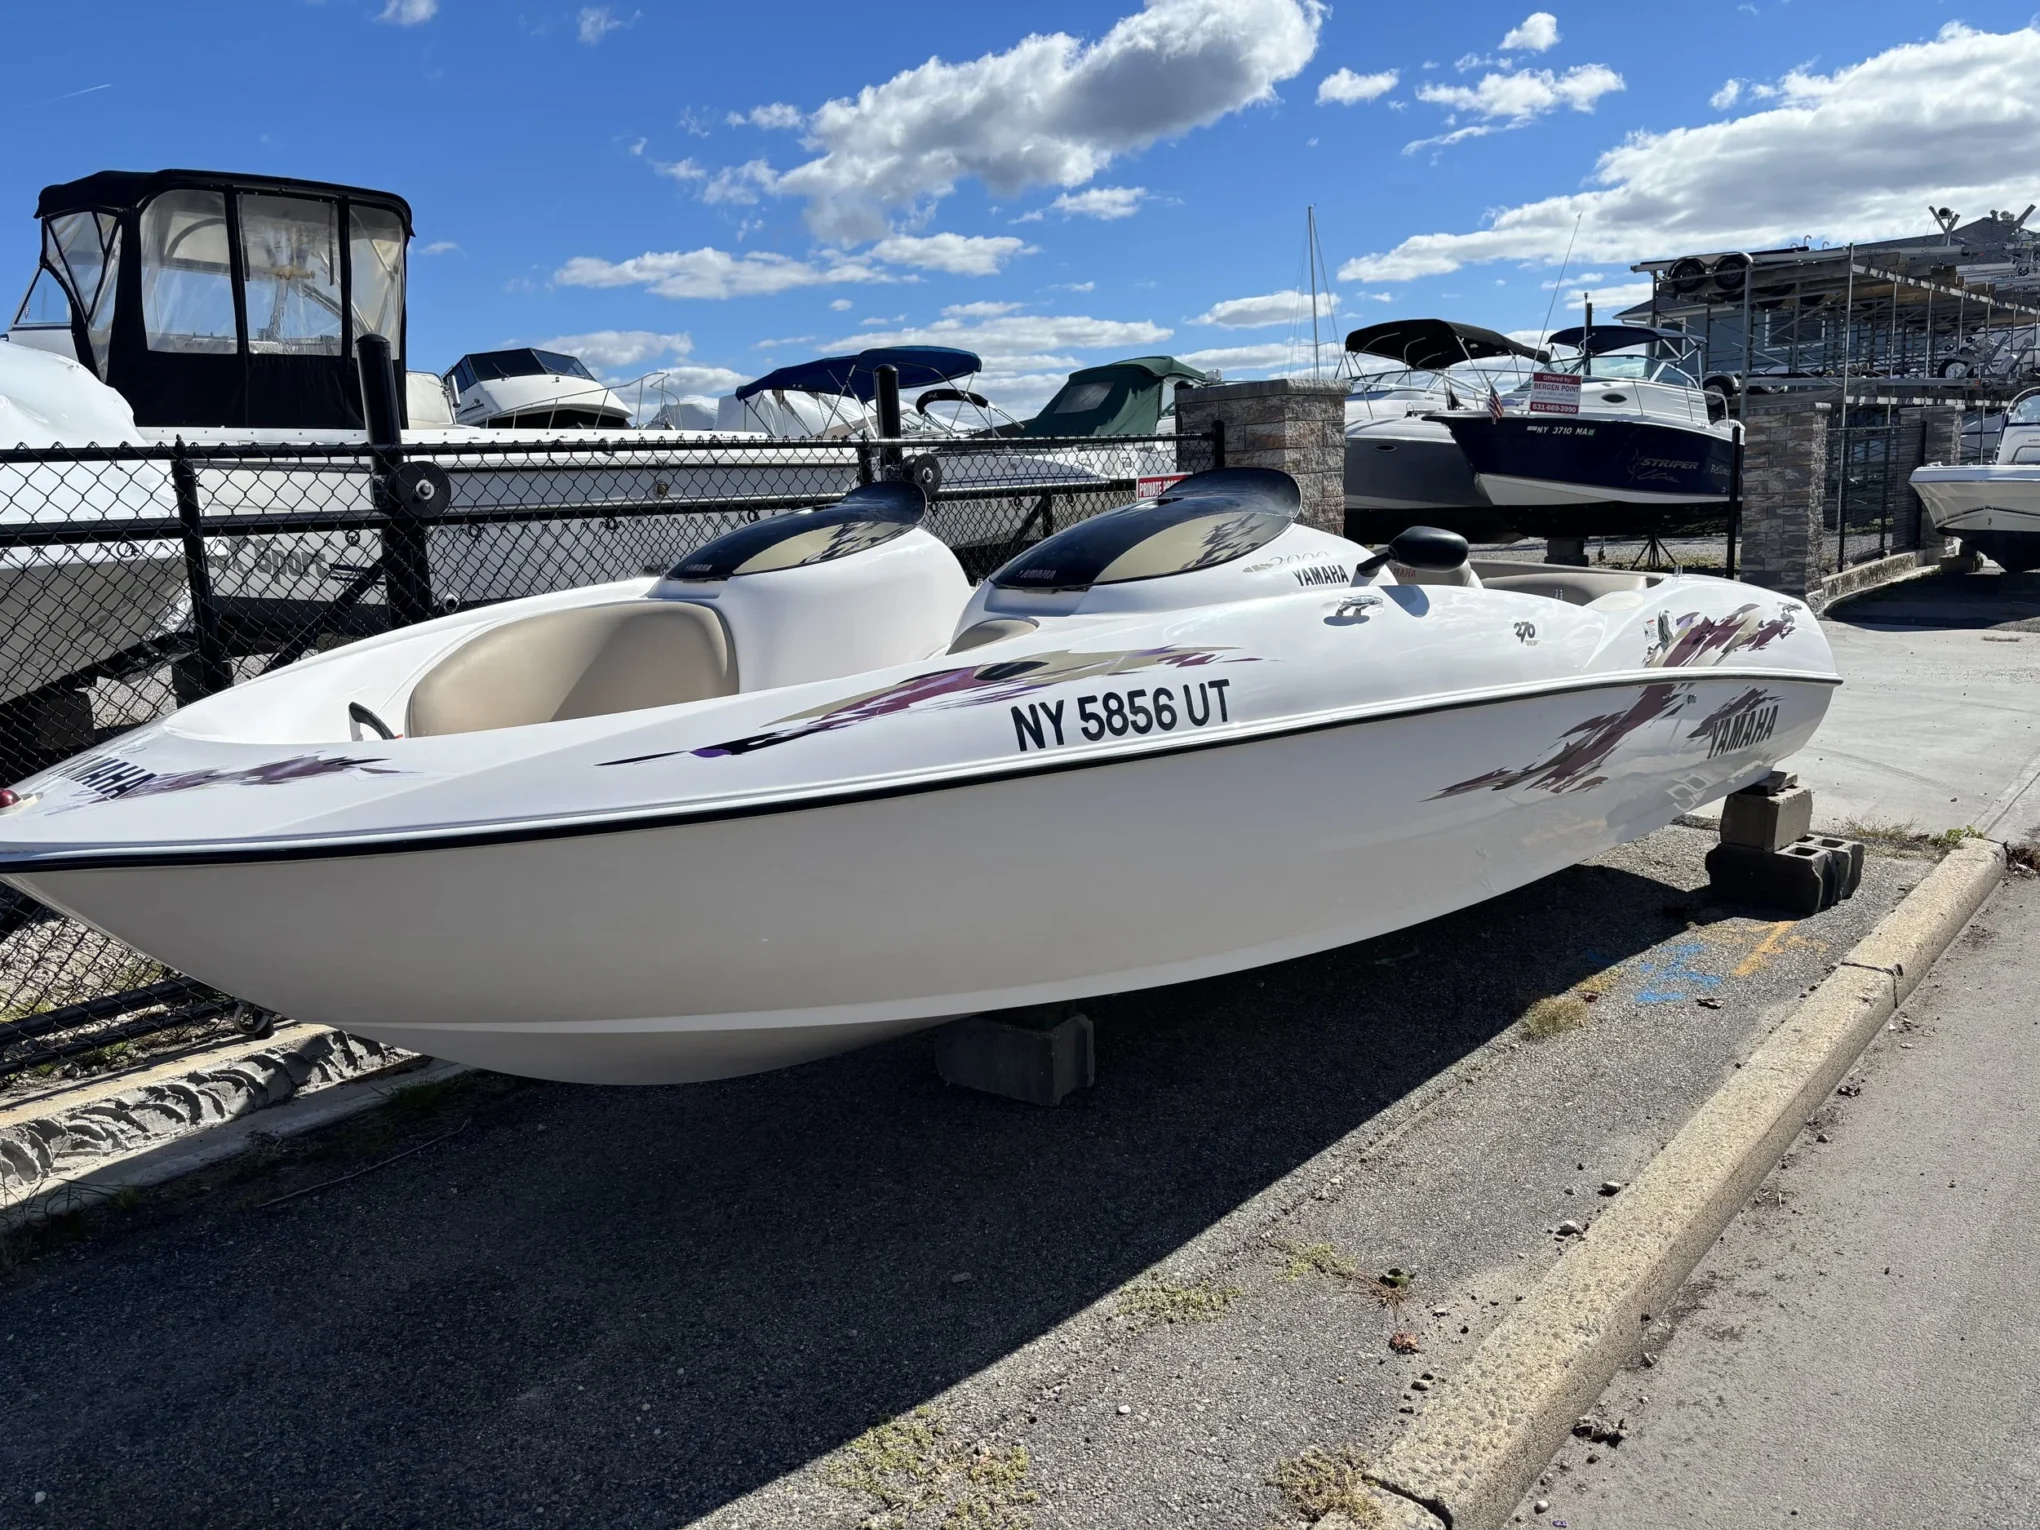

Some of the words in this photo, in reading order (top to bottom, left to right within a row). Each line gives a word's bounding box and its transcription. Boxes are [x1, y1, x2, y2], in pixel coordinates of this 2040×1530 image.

[1533, 383, 1560, 391] BERGEN
[1561, 385, 1580, 393] POINT
[1532, 403, 1577, 413] 631-669-3990
[1536, 426, 1549, 434] NY
[1552, 426, 1573, 435] 3710
[1575, 427, 1588, 435] MA
[1640, 458, 1700, 470] STRIPER
[1139, 480, 1163, 497] PRIVATE
[254, 538, 330, 584] Sport
[684, 563, 713, 572] YAMAHA
[1016, 569, 1057, 580] YAMAHA
[1292, 564, 1350, 587] YAMAHA
[1513, 621, 1536, 644] 270
[1010, 699, 1065, 752] NY
[1077, 687, 1178, 742] 5856
[1183, 678, 1231, 727] UT
[1706, 704, 1779, 760] YAMAHA
